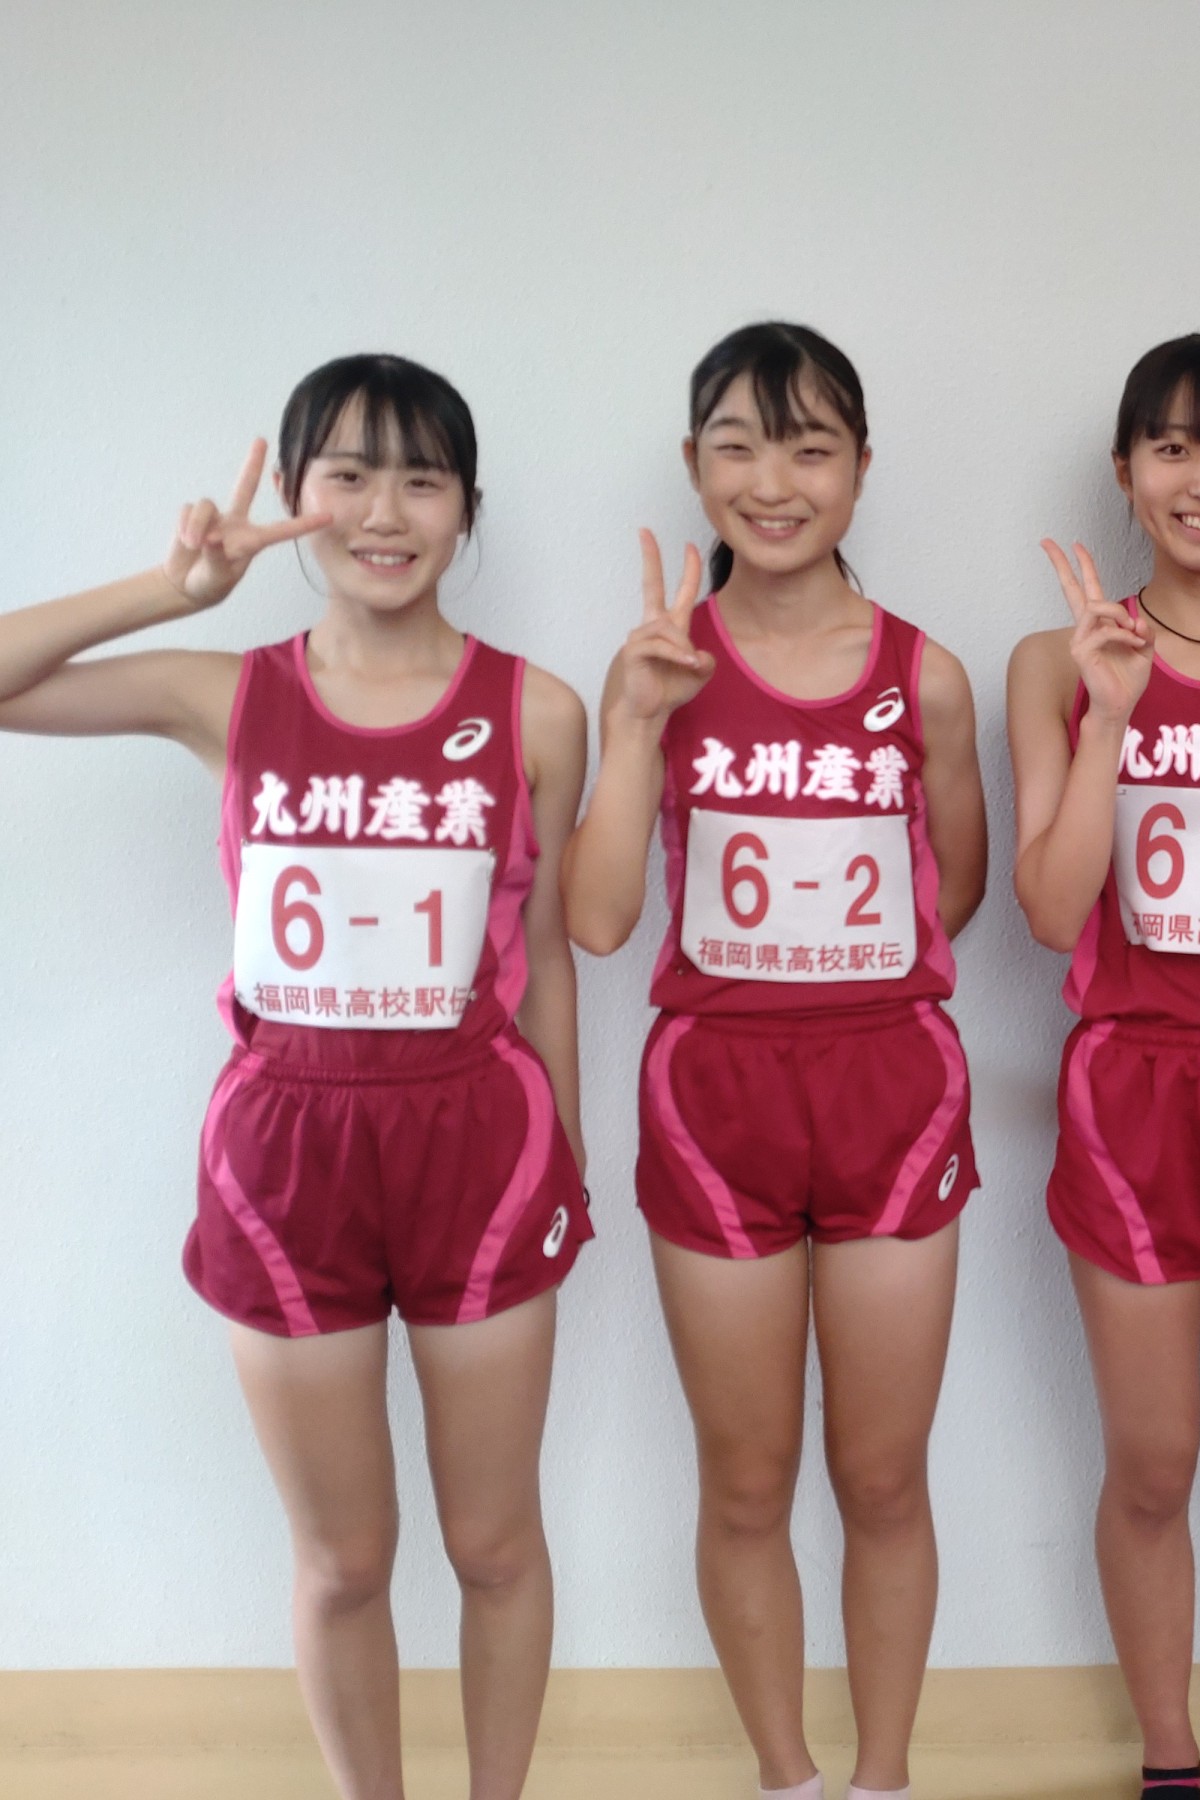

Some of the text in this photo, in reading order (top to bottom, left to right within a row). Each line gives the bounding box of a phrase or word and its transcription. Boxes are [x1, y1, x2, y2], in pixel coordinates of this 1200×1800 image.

[250, 771, 496, 847] 九州産業
[689, 737, 909, 810] 九州産業
[721, 831, 882, 930] 6-2
[270, 864, 443, 972] 6-1
[698, 936, 904, 974] 福岡県高校駅伝
[253, 982, 467, 1019] 福岡県高校駅伝
